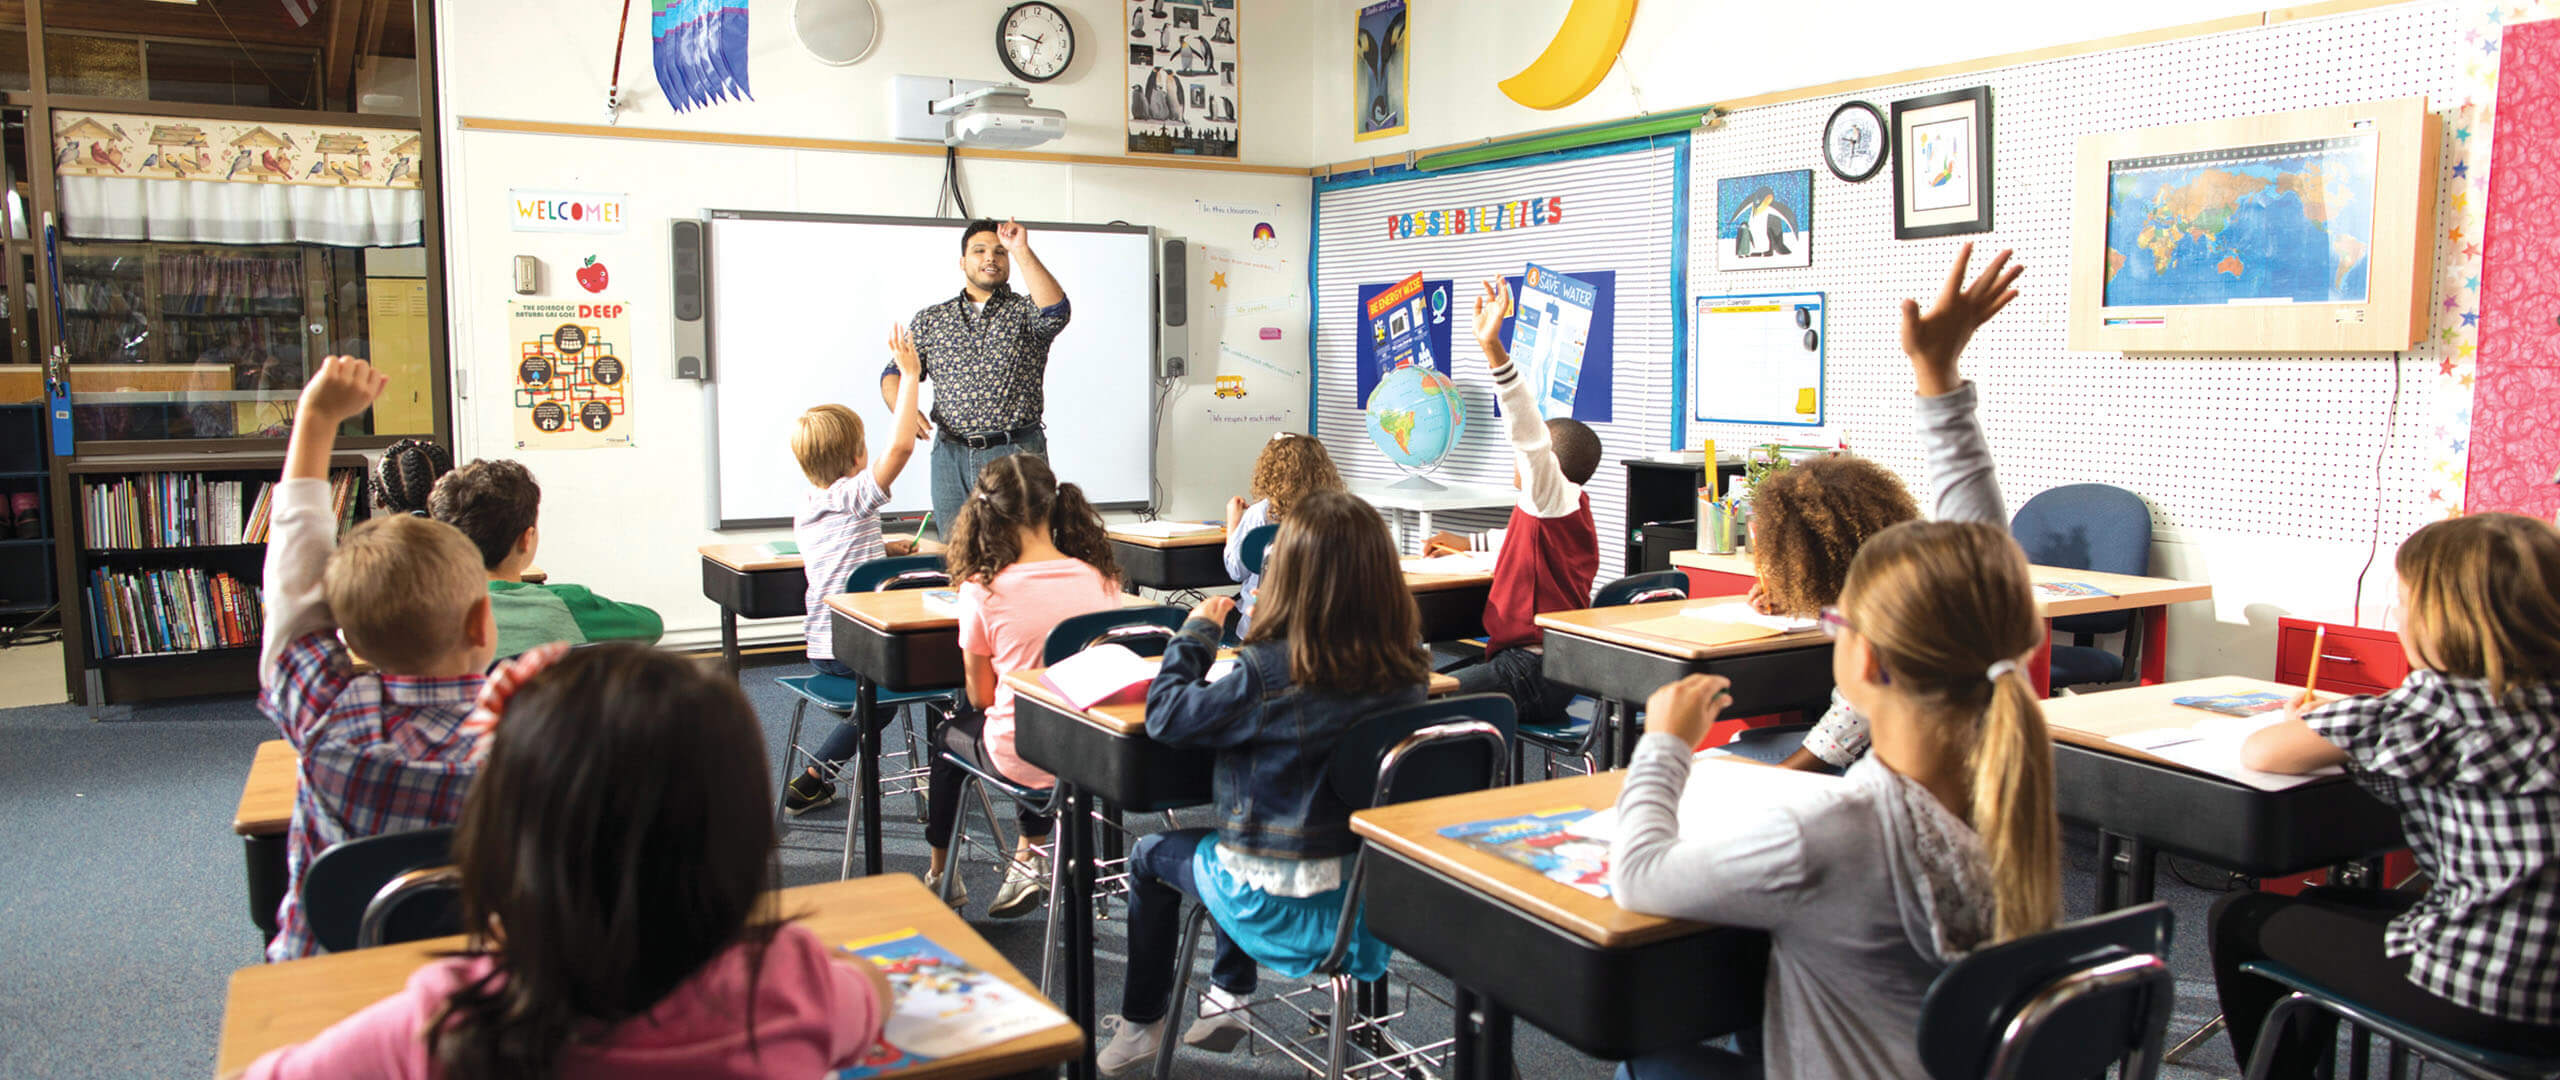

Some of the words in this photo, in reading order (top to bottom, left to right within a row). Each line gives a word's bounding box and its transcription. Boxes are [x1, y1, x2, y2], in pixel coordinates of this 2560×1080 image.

[516, 199, 620, 223] WELCOME!
[1388, 197, 1562, 240] POSSIBILITIES
[1369, 301, 1378, 315] BE
[1379, 288, 1401, 311] ENERGY
[1402, 276, 1421, 298] WISE
[1539, 276, 1560, 296] SAVE
[1563, 283, 1592, 309] WATER
[578, 304, 623, 319] DEEP
